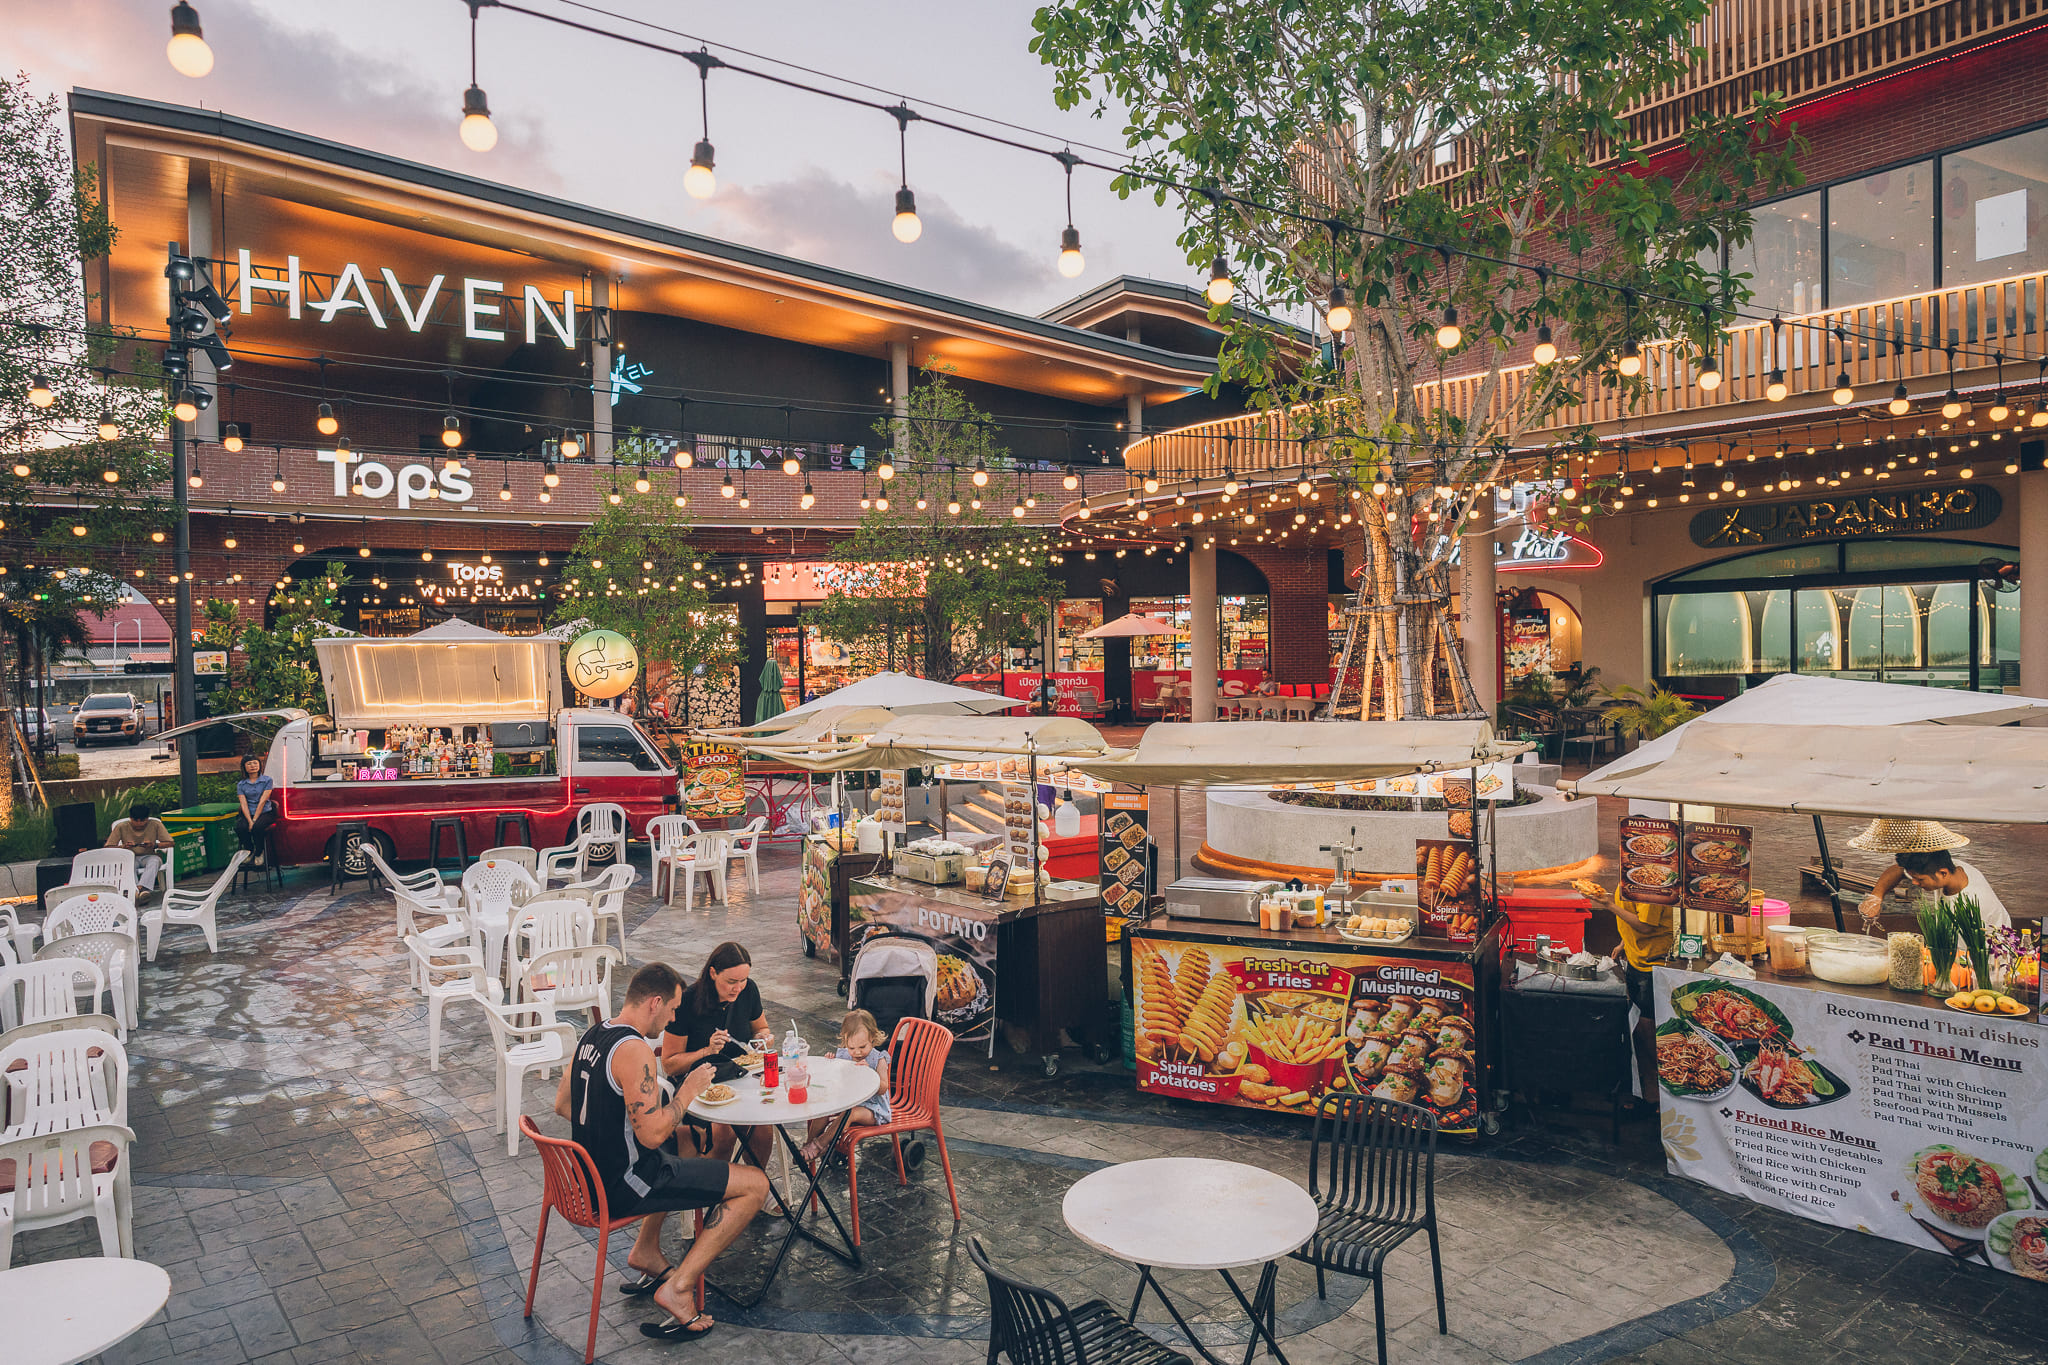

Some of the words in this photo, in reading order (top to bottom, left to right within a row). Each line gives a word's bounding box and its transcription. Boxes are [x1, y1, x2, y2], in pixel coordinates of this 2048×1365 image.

[238, 248, 576, 349] HAVEN
[317, 449, 474, 510] Tops
[1760, 488, 1977, 532] JAPANIKO
[1512, 529, 1572, 559] Hut
[447, 562, 502, 583] Tops
[421, 587, 468, 597] WINE
[474, 586, 530, 597] CELLAR
[1513, 623, 1547, 635] Pretza
[358, 768, 398, 781] BAR
[698, 755, 728, 765] FOOD
[1628, 820, 1645, 828] PAD
[1648, 821, 1669, 830] THAI
[1695, 825, 1713, 833] PAD
[1715, 827, 1740, 836] THAI
[919, 907, 986, 941] POTATO
[1436, 906, 1458, 915] Spiral
[1245, 958, 1330, 977] Fresh-Cut
[1268, 973, 1312, 989] Fries
[1379, 966, 1439, 985] Grilled
[1361, 980, 1461, 1001] Mushrooms
[1826, 1003, 1930, 1031] Recommend
[1933, 1020, 1974, 1039] Thai
[1979, 1027, 2039, 1049] dishes
[1869, 1031, 1905, 1051] Pad
[1909, 1039, 1956, 1059] Thai
[1960, 1047, 2022, 1072] Menu
[1871, 1053, 1892, 1065] Pad
[1894, 1058, 1920, 1070] Thai
[1150, 1071, 1216, 1093] Potatoes
[1160, 1060, 1203, 1077] Spiral
[1872, 1065, 1892, 1076] Pad
[1895, 1069, 1921, 1082] Thai
[1926, 1076, 1954, 1088] with
[1956, 1081, 2007, 1098] Chicken
[579, 1070, 591, 1125] 7
[1872, 1076, 1893, 1087] Pad
[1895, 1081, 1922, 1093] Thai
[1926, 1087, 1954, 1099] with
[1957, 1093, 2003, 1111] Shrimp
[1873, 1087, 1894, 1098] Pad
[1896, 1092, 1922, 1104] Thai
[1927, 1098, 1955, 1111] with
[1957, 1104, 2007, 1122] Mussels
[1873, 1098, 1919, 1115] Seefood
[1922, 1108, 1944, 1120] Pad
[1946, 1113, 1973, 1126] Thai
[1735, 1109, 1787, 1130] Friend
[1791, 1120, 1826, 1138] Rice
[1829, 1128, 1877, 1149] Menu
[1874, 1111, 1895, 1123] Pad
[1897, 1116, 1923, 1128] Thai
[1927, 1123, 1954, 1136] with
[1956, 1129, 1989, 1143] River
[1991, 1136, 2034, 1153] Prawn
[1734, 1125, 1763, 1139] Fried
[1765, 1132, 1788, 1144] Rice
[1791, 1138, 1817, 1150] with
[1819, 1143, 1883, 1165] Vegetables
[1734, 1138, 1763, 1152] Fried
[1765, 1145, 1789, 1157] Rice
[1791, 1151, 1817, 1163] with
[1819, 1157, 1867, 1175] Chicken
[1735, 1151, 1763, 1165] Fried
[1765, 1158, 1789, 1170] Rice
[1790, 1164, 1817, 1177] with
[1819, 1170, 1862, 1188] Shrimp
[1737, 1163, 1762, 1178] Fried
[1765, 1171, 1789, 1183] Rice
[1790, 1178, 1817, 1190] with
[1819, 1184, 1848, 1198] Crab
[1740, 1175, 1777, 1194] Seafood
[1778, 1188, 1808, 1203] Fried
[1811, 1196, 1836, 1209] Rice
